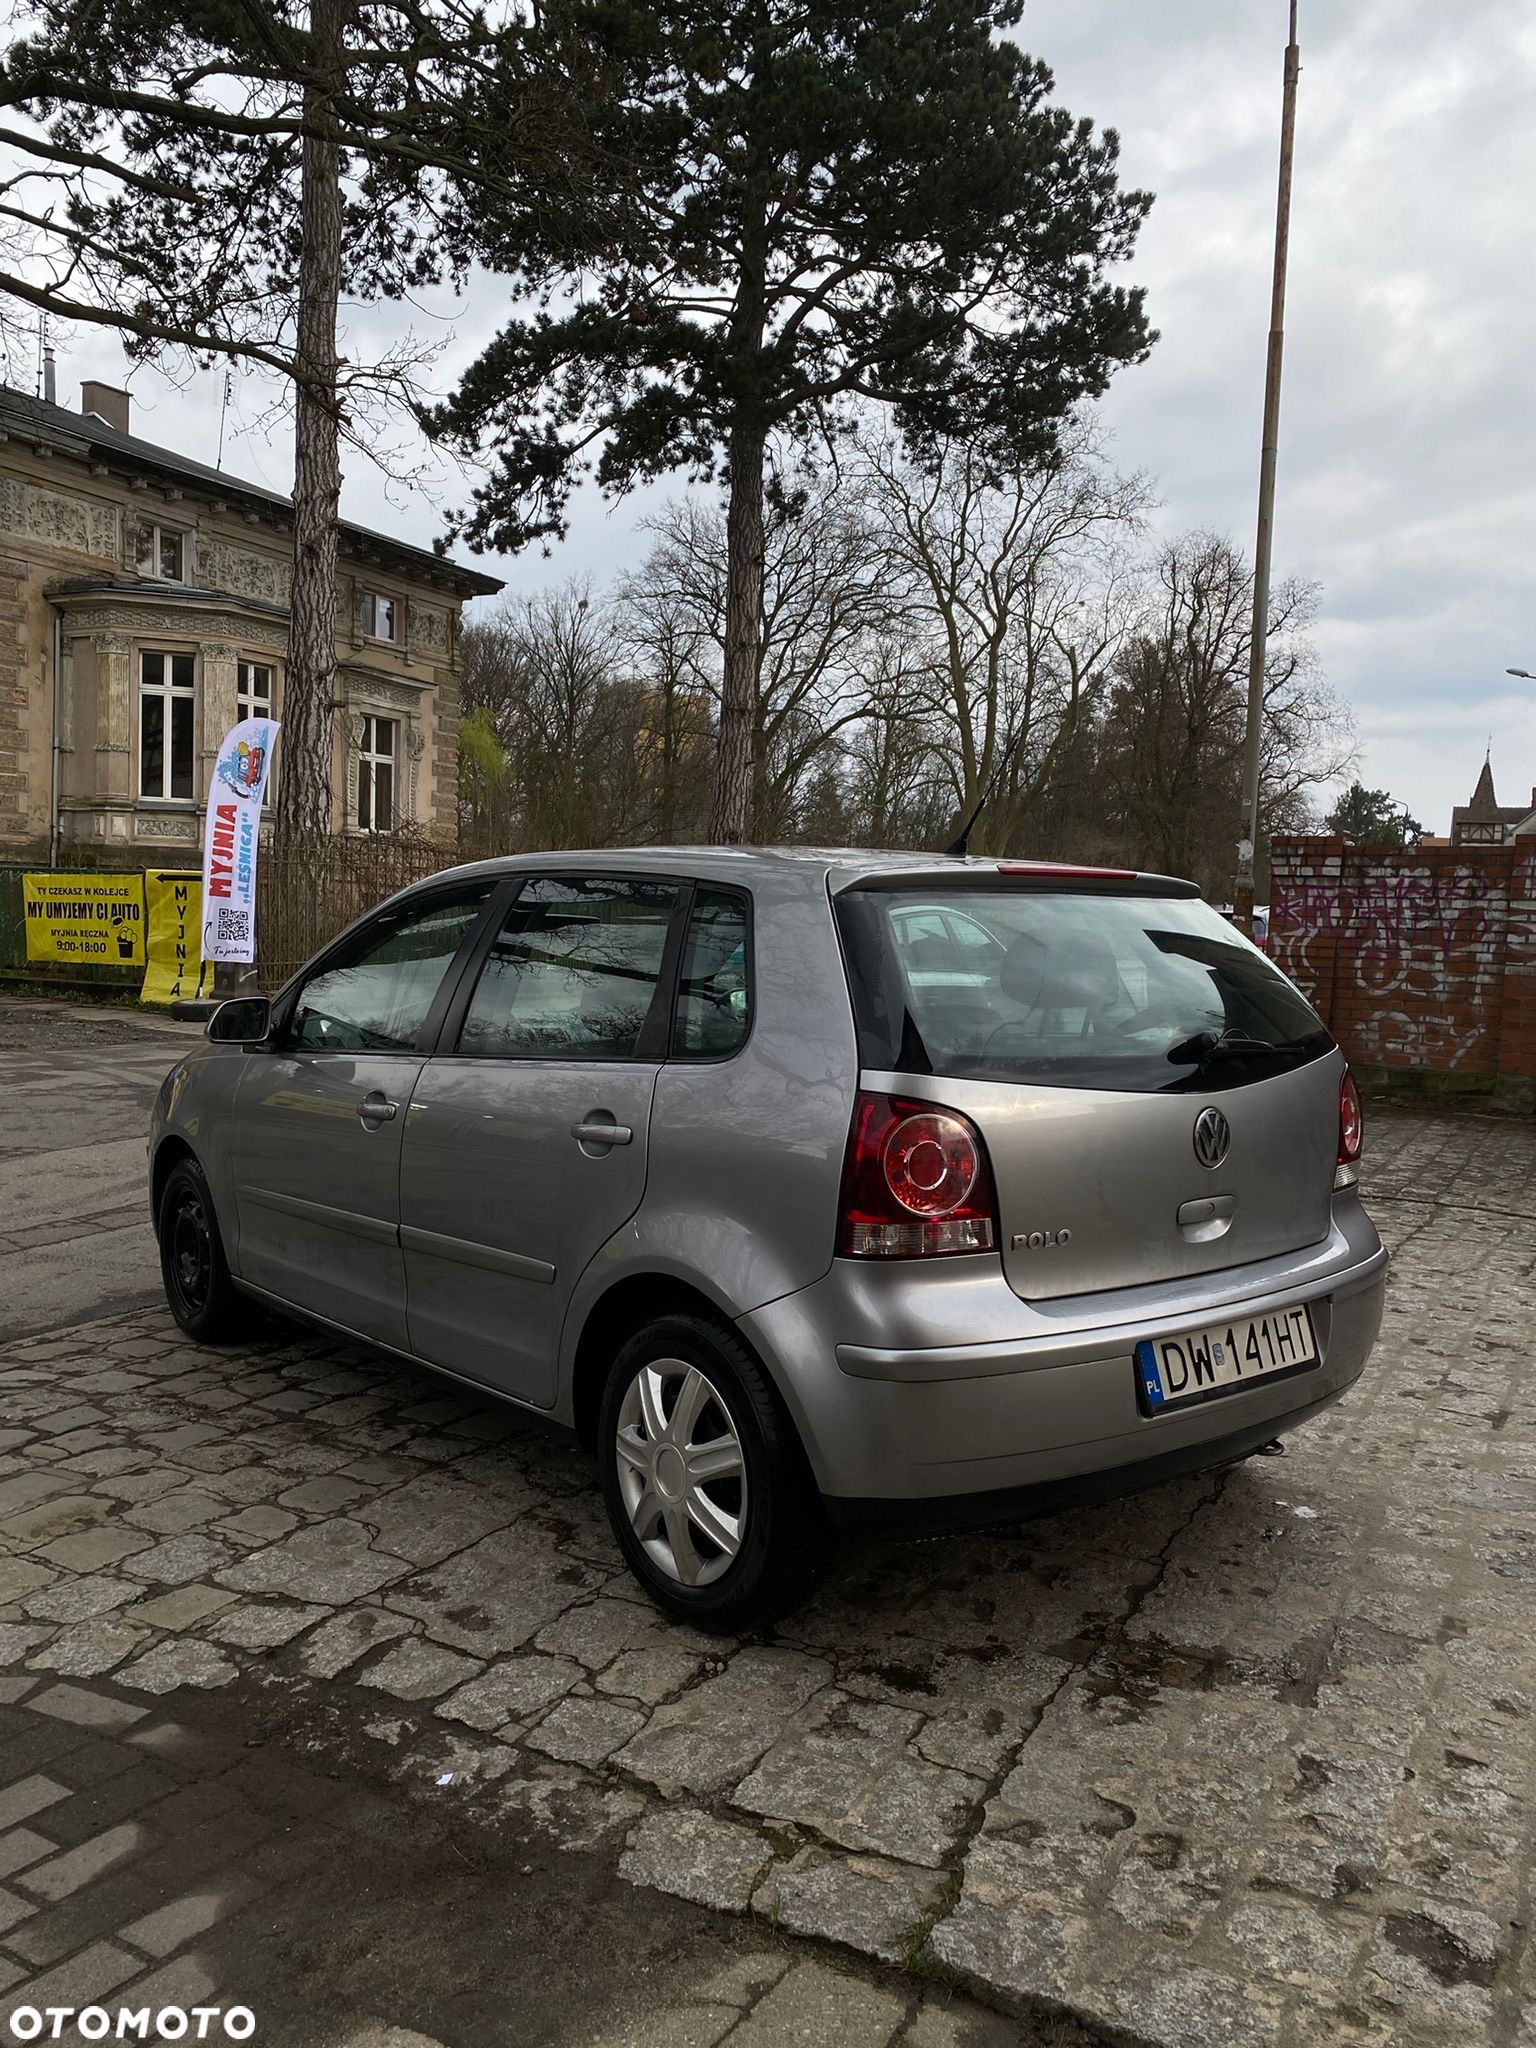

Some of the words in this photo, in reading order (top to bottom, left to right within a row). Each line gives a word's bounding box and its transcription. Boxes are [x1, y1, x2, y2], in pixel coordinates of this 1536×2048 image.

[209, 804, 237, 898] MYJNIA
[38, 887, 46, 895] TY
[49, 887, 82, 896] CZEKASZ
[84, 888, 92, 896] W
[93, 888, 129, 896] KOLEJCE
[27, 901, 43, 918] MY
[46, 902, 94, 919] UMYJEMY
[96, 903, 108, 920] CI
[110, 903, 140, 921] AUTO
[51, 929, 78, 937] MYJNIA
[80, 930, 109, 939] RĘCZNA
[170, 886, 187, 996] MYJNIA
[56, 940, 107, 953] 9:00-18:00
[1012, 1227, 1072, 1252] POLO
[1161, 1334, 1216, 1393] DW
[1225, 1310, 1307, 1376] 141HT
[1146, 1380, 1161, 1395] PL
